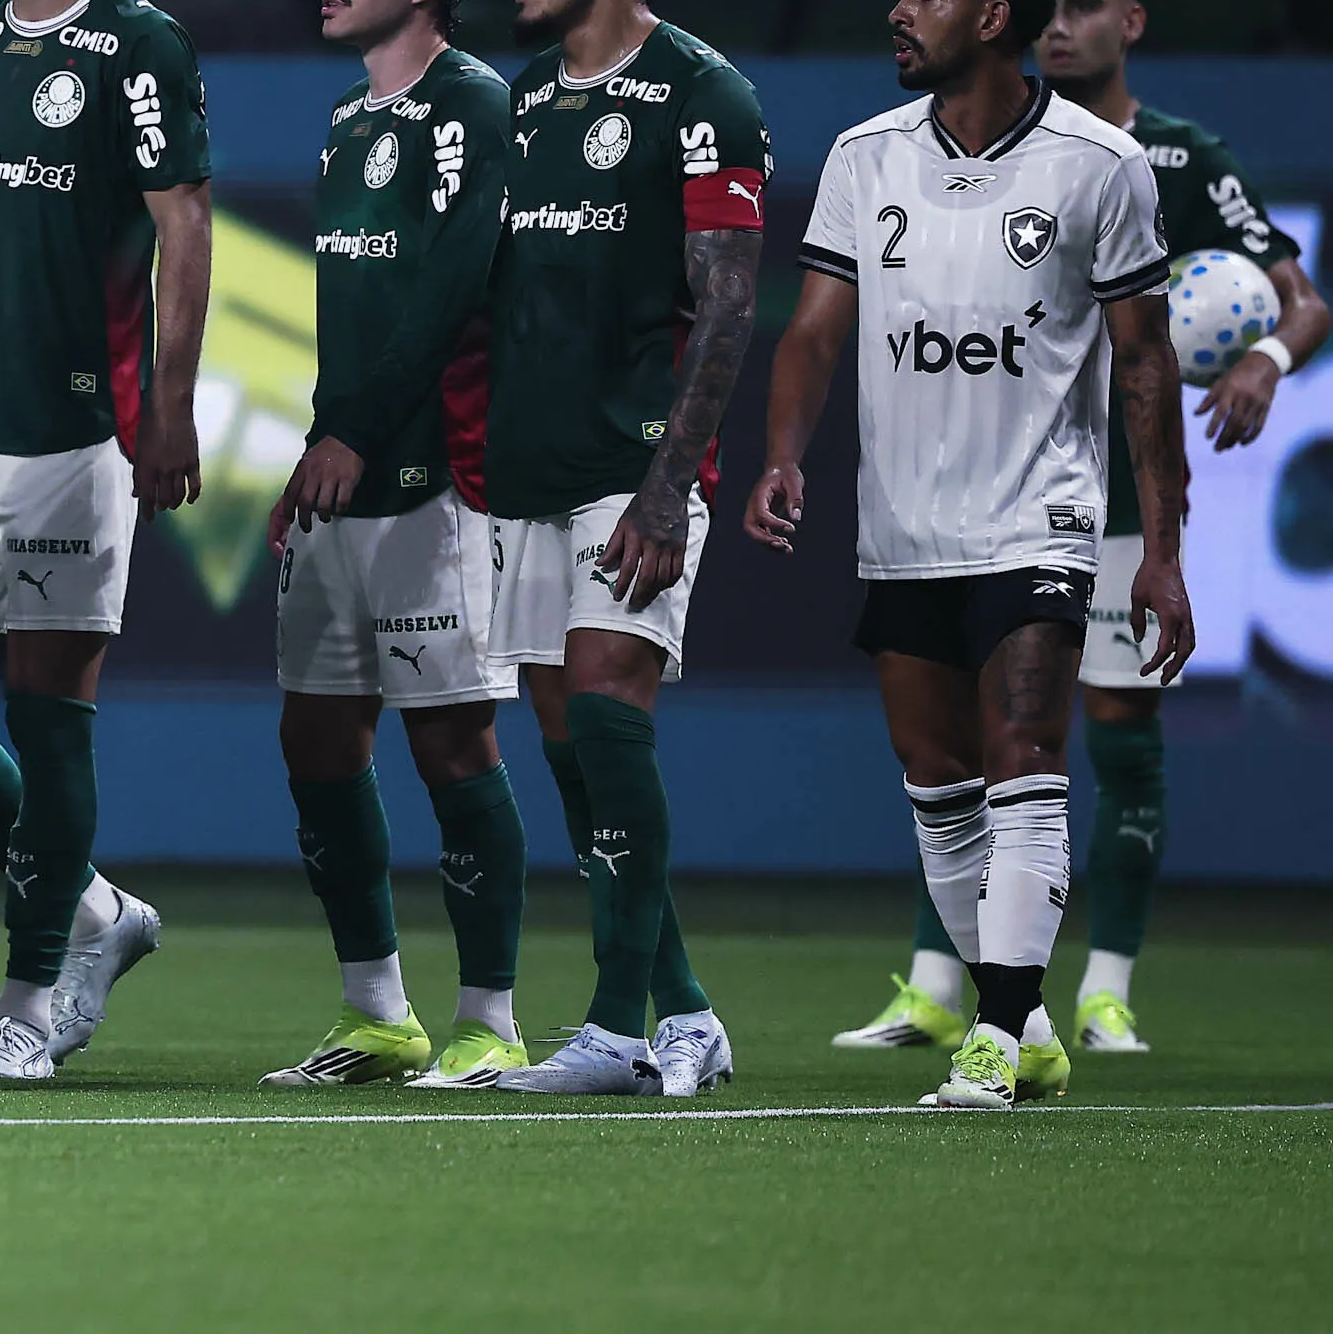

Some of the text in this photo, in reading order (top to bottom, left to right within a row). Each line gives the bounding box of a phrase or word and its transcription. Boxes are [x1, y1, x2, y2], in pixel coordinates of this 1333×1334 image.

[58, 25, 119, 56] CIMED
[606, 76, 671, 103] CIMED
[512, 201, 627, 235] portingbet
[877, 205, 907, 269] 2
